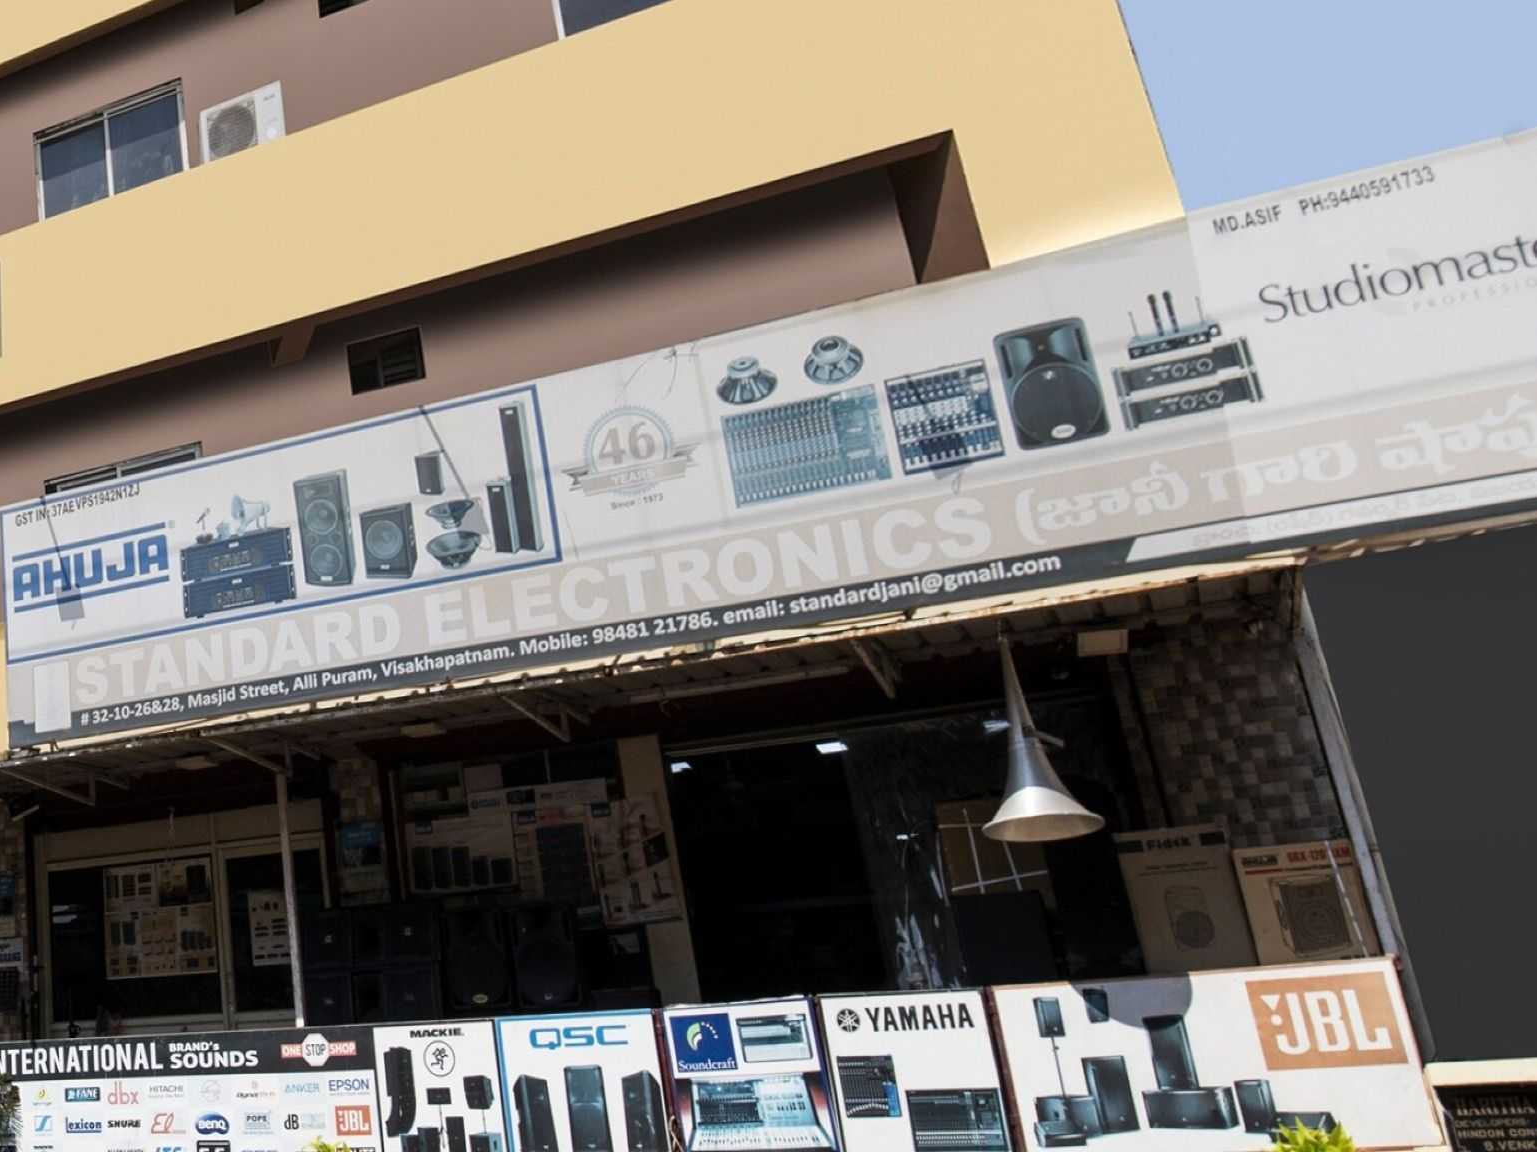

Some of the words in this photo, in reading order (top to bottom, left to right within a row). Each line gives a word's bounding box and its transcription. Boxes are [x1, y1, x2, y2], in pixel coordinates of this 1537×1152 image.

[1212, 204, 1282, 235] MD.ASIF
[598, 421, 656, 464] 46
[14, 512, 34, 527] GST
[13, 534, 170, 603] AHUJA
[75, 602, 401, 704] STANDARD
[424, 497, 992, 647] ELECTRONICS
[81, 713, 89, 726] #
[92, 698, 184, 725] 32-10-26&28,
[188, 686, 237, 709] Masjid
[239, 679, 290, 700] Street,
[293, 673, 318, 692] Alli
[322, 667, 377, 687] Puram,
[381, 644, 515, 676] Visakhapatnam.
[519, 632, 588, 656] Mobile:
[592, 622, 649, 645] 98481
[653, 611, 718, 636] 21786.
[723, 599, 786, 625] email:
[790, 554, 1062, 615] standardjani@gmail.com
[864, 1002, 976, 1033] YAMAHA
[1275, 988, 1394, 1056] JBL
[409, 1027, 463, 1039] MACKIE
[529, 1023, 630, 1051] QSC
[283, 1045, 302, 1057] ONE
[305, 1043, 327, 1057] STOP
[329, 1041, 356, 1055] SHOP
[169, 1050, 259, 1070] SOUNDS
[678, 1057, 736, 1072] Soundcraft
[107, 1081, 140, 1105] dbx
[149, 1084, 184, 1093] HITACHI
[328, 1078, 370, 1092] EPSON
[65, 1116, 103, 1133] lexicon
[107, 1119, 142, 1129] SHURE
[283, 1113, 300, 1130] dB
[340, 1110, 370, 1132] JBL
